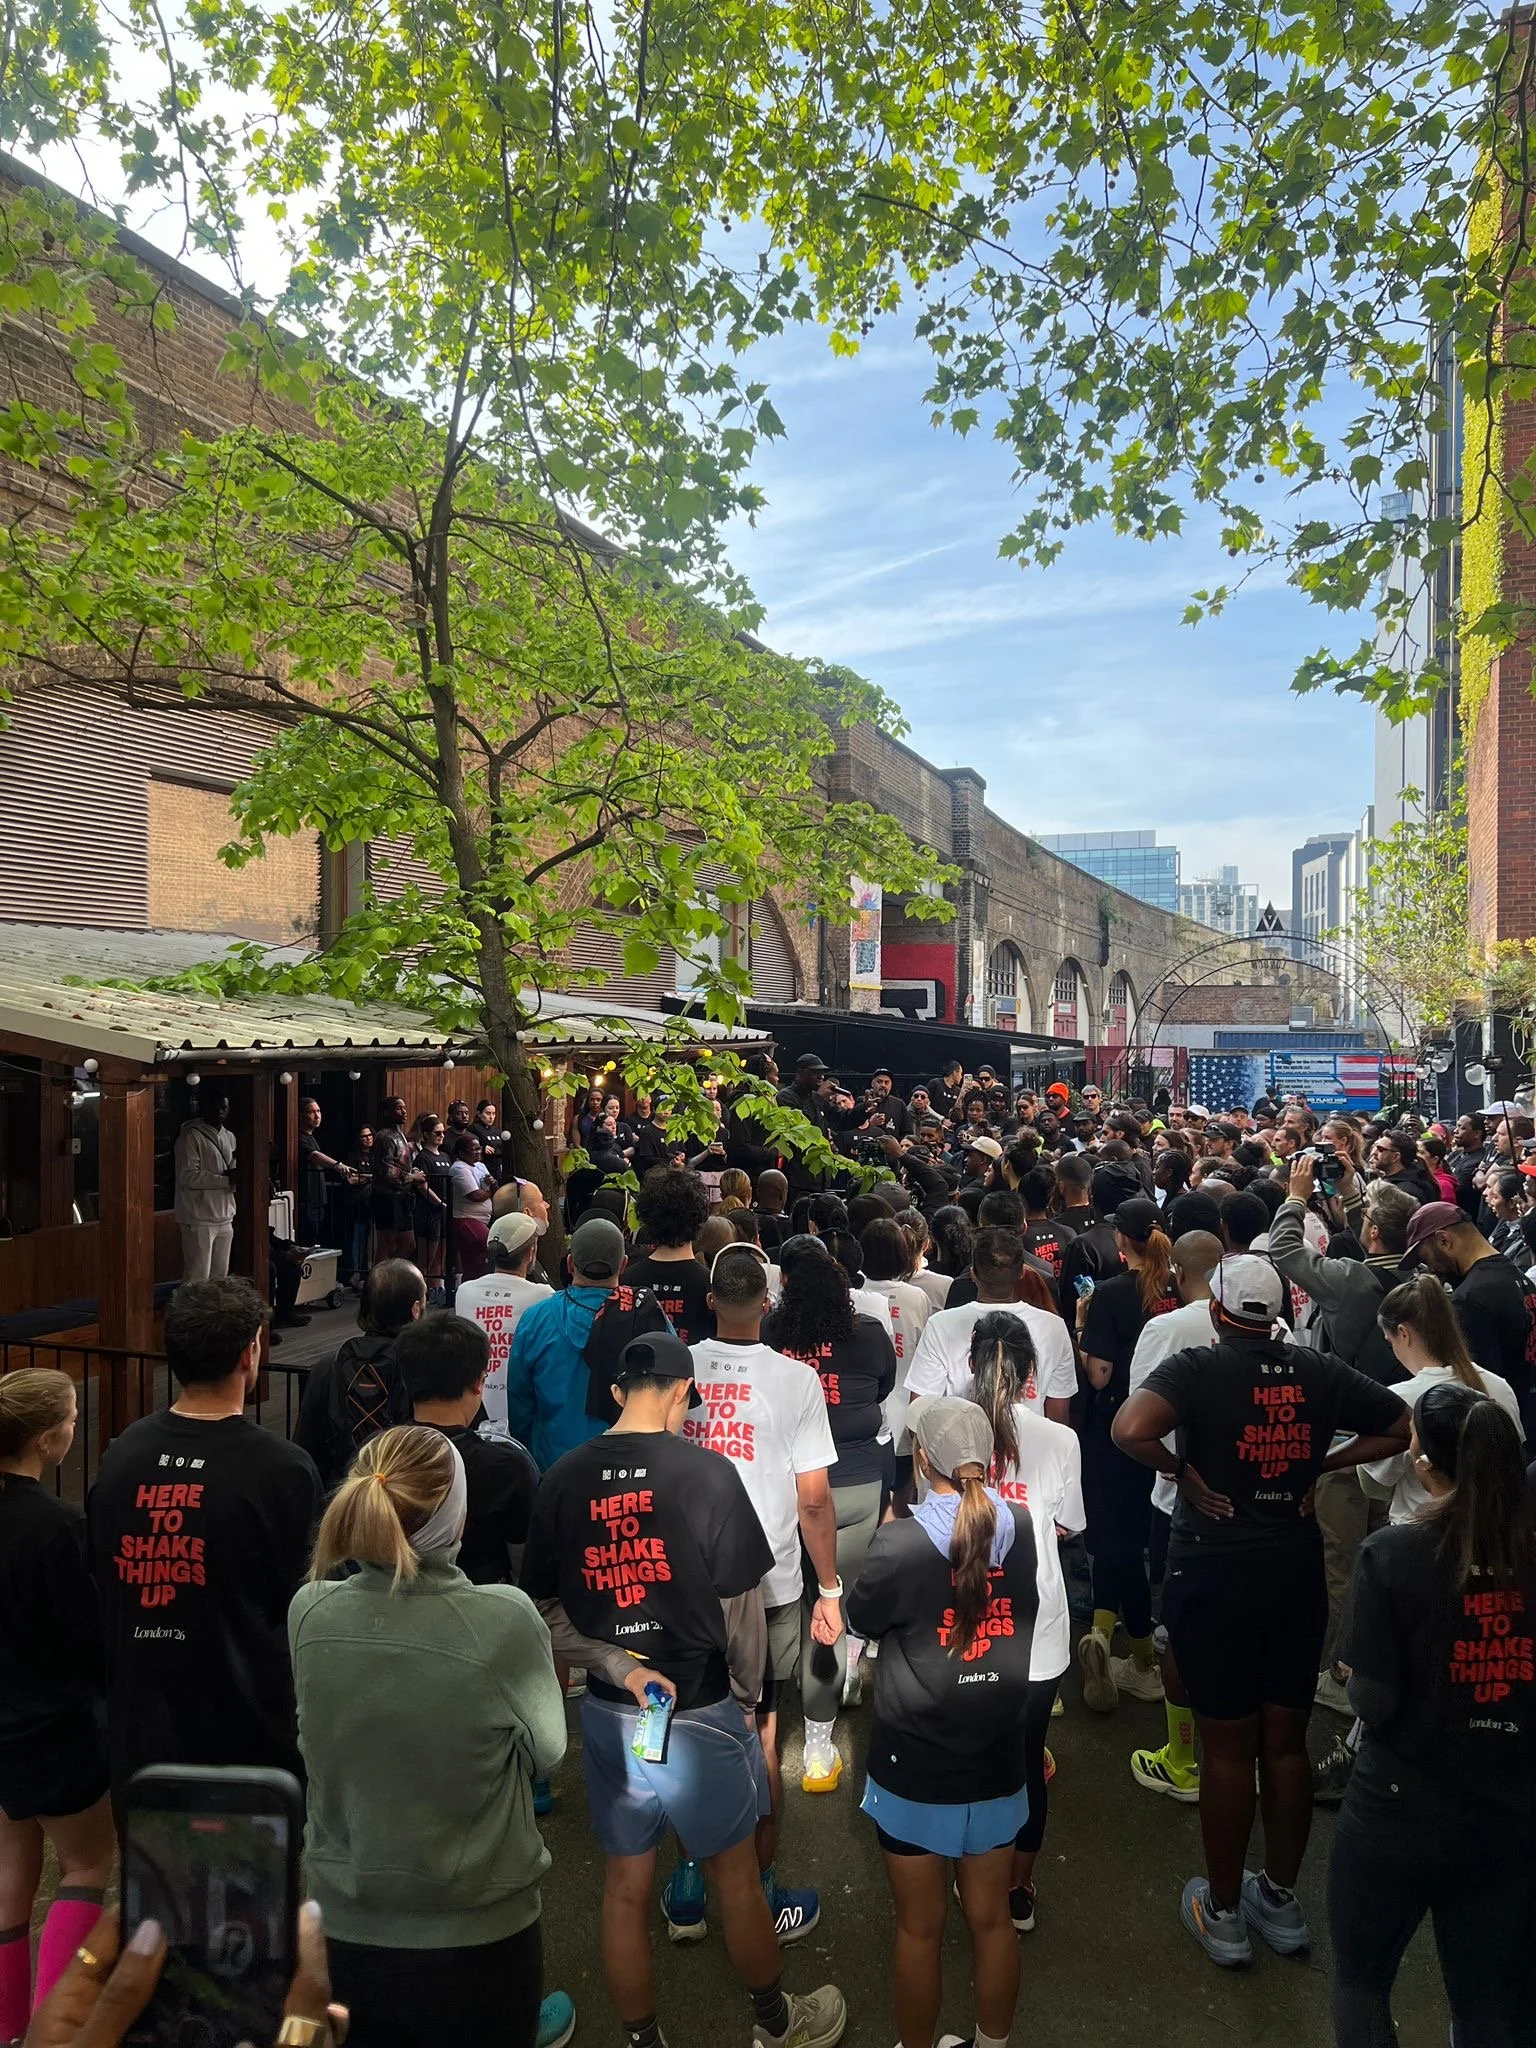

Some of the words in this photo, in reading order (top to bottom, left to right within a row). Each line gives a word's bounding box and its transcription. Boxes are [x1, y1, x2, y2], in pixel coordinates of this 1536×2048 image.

[1035, 1243, 1059, 1256] HERE
[619, 1286, 634, 1312] ERE
[476, 1306, 513, 1319] HERE
[484, 1320, 502, 1332] TO
[489, 1333, 514, 1346] AKE
[698, 1383, 752, 1401] HERE
[1254, 1385, 1305, 1405] HERE
[707, 1402, 736, 1418] TO
[1266, 1405, 1296, 1424] TO
[683, 1420, 755, 1442] SHAKE
[1244, 1424, 1311, 1443] SHAKE
[1236, 1440, 1310, 1462] THINGS
[1260, 1461, 1289, 1478] UP
[136, 1484, 204, 1508] HERE
[590, 1490, 653, 1520] HERE
[1254, 1490, 1282, 1500] London
[149, 1510, 183, 1533] TO
[606, 1516, 639, 1540] TO
[121, 1535, 205, 1562] SHAKE
[584, 1538, 666, 1568] SHAKE
[114, 1556, 206, 1586] THINGS
[581, 1561, 672, 1590] THINGS
[141, 1584, 176, 1608] UP
[615, 1584, 646, 1608] UP
[1464, 1590, 1524, 1616] HERE
[943, 1598, 1012, 1627] SKE
[134, 1626, 172, 1639] London
[615, 1622, 650, 1636] London
[937, 1618, 1014, 1646] TNGS
[1479, 1614, 1510, 1638] TO
[1454, 1636, 1534, 1660] SHAKE
[958, 1673, 986, 1684] London
[1449, 1660, 1534, 1682] THINGS
[1474, 1682, 1510, 1703] UP
[1469, 1718, 1502, 1730] London
